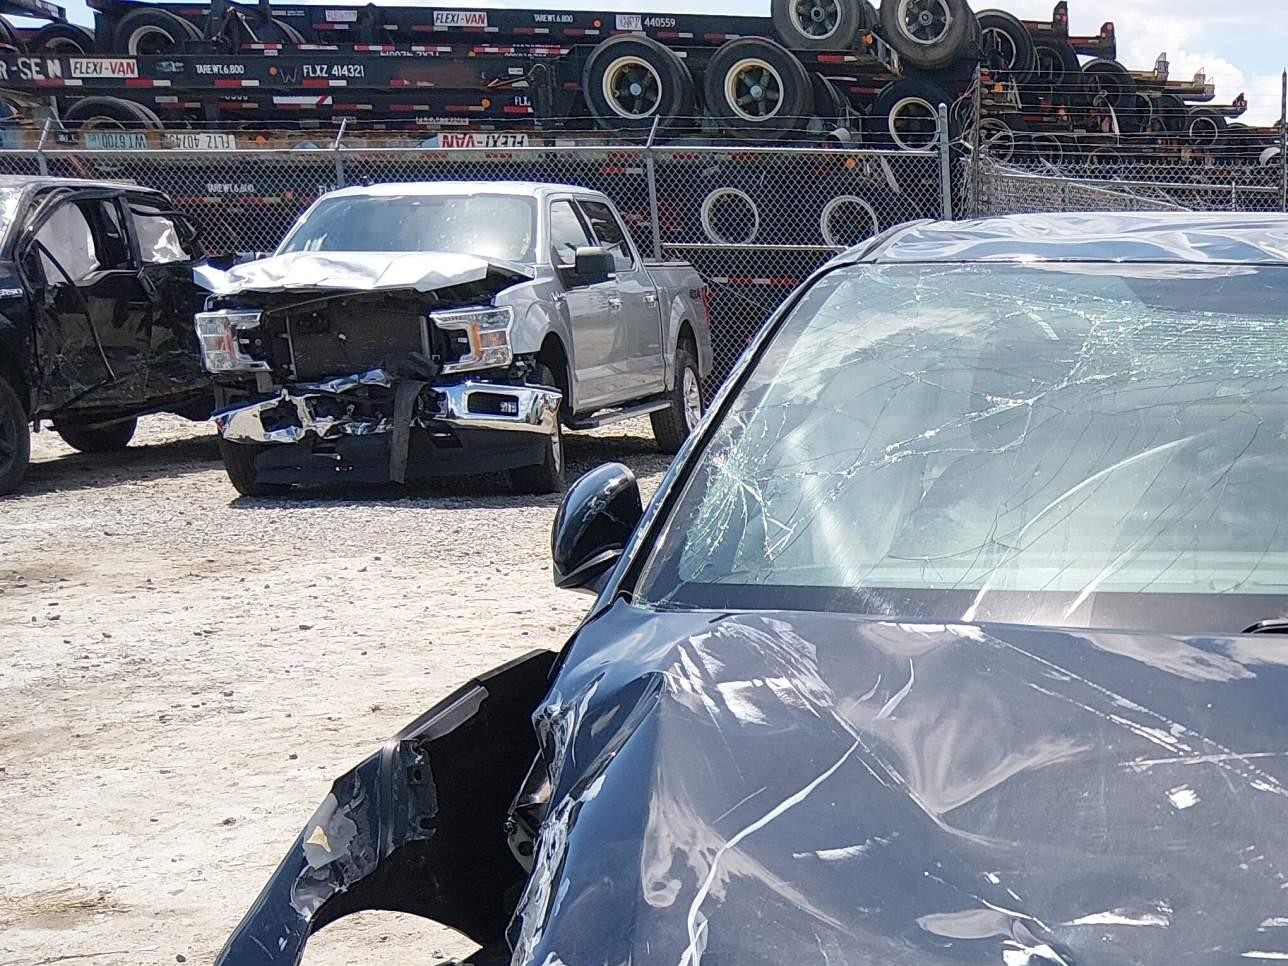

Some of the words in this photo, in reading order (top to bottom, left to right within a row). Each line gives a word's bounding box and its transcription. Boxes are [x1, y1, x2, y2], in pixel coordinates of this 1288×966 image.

[435, 13, 486, 25] FLEXI-VAN
[644, 16, 676, 27] 440559
[73, 61, 135, 76] FLEXI-VAN
[303, 65, 328, 77] FLXZ
[331, 65, 364, 78] 414321
[207, 134, 230, 148] FLTZ
[442, 134, 525, 148] FLEXI-VAN
